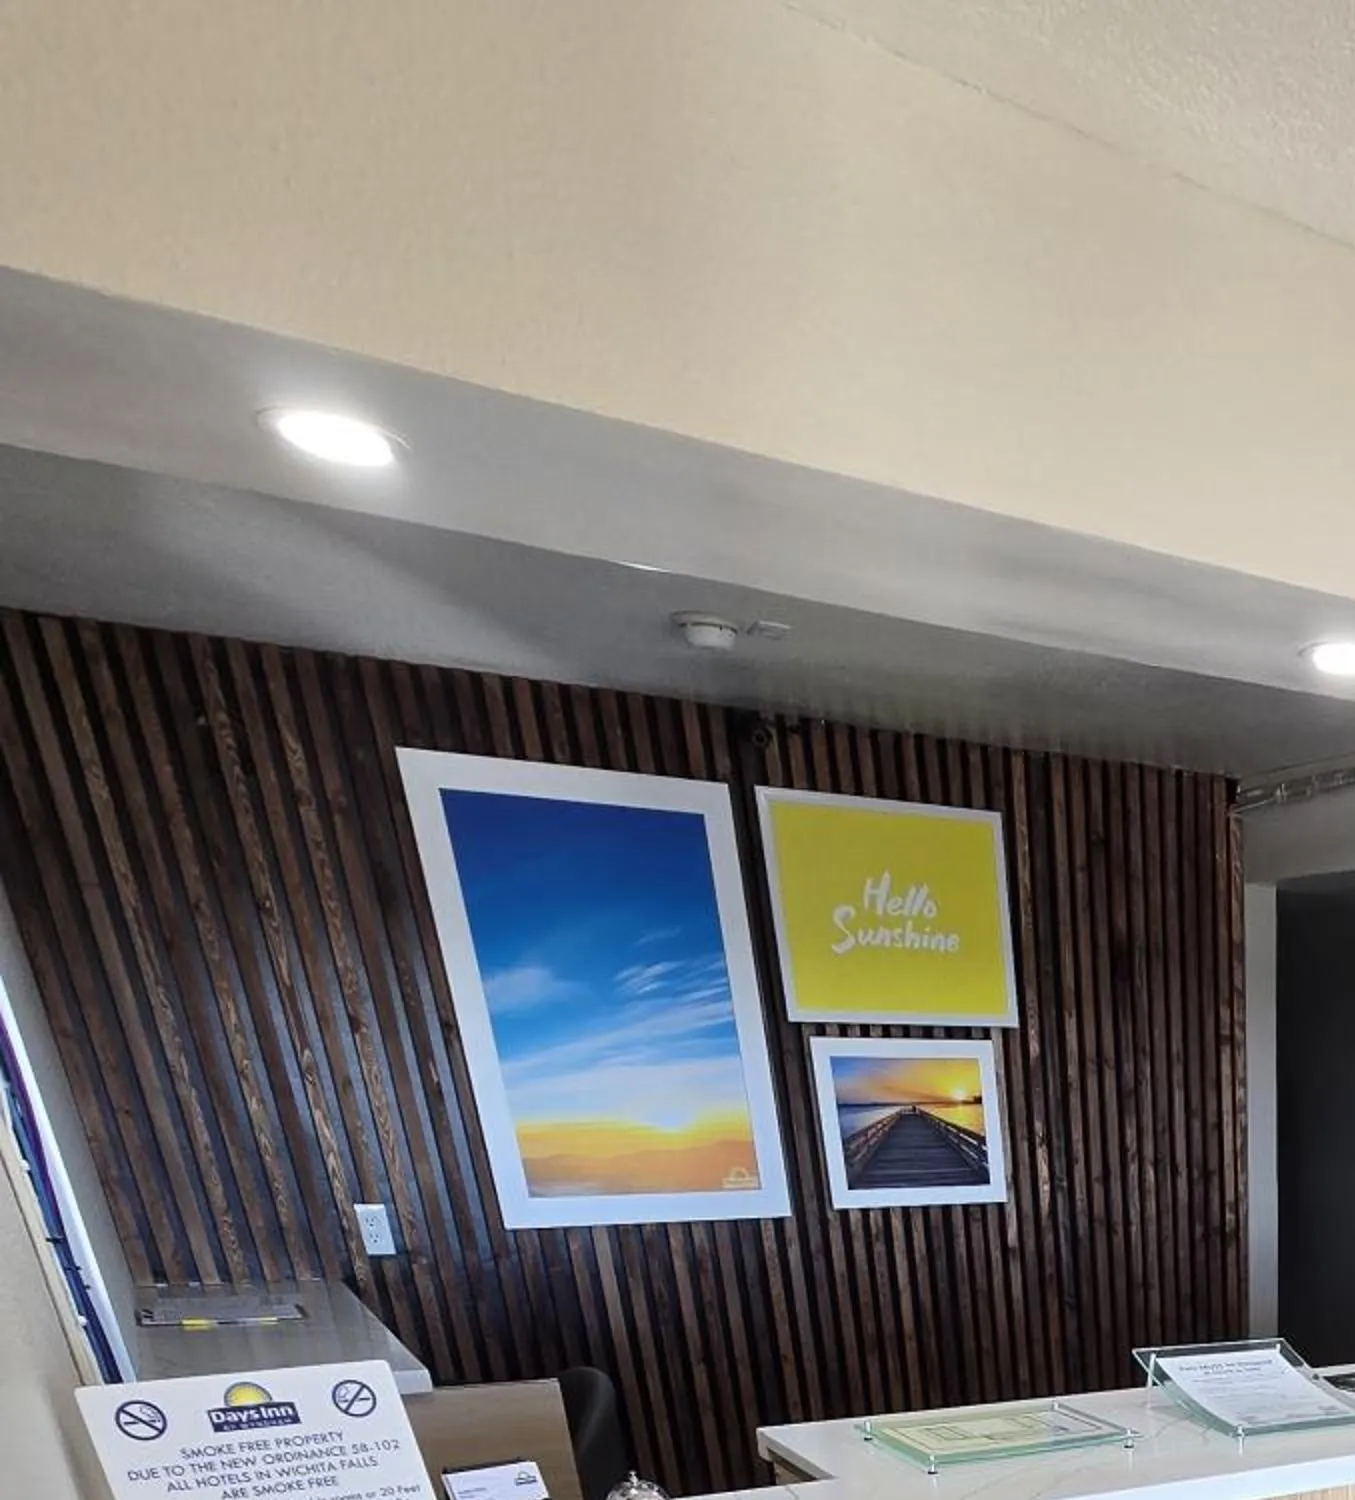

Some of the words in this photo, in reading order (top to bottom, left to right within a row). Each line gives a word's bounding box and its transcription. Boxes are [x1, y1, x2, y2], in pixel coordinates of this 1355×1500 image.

[863, 869, 938, 919] Hello
[831, 904, 961, 955] Sunshine
[210, 1407, 259, 1423] Days
[260, 1405, 295, 1419] Inn
[127, 1467, 160, 1482] DUE
[162, 1464, 185, 1477] TO
[189, 1461, 218, 1475] THE
[220, 1455, 257, 1470] NEW
[261, 1445, 347, 1466] ORDINANCE
[351, 1439, 400, 1455] 58-102
[180, 1443, 236, 1460] SMOKE
[239, 1439, 272, 1453] FREE
[275, 1431, 343, 1449] PROPERTY
[167, 1479, 193, 1493] ALL
[195, 1471, 252, 1489] HOTELS
[254, 1469, 272, 1481] IN
[275, 1461, 338, 1478] WICHITA
[340, 1455, 379, 1471] FALLS
[221, 1488, 249, 1500] ARE
[252, 1480, 305, 1498] SMOKE
[307, 1476, 339, 1490] FREE
[365, 1490, 377, 1499] or
[380, 1486, 395, 1497] 20
